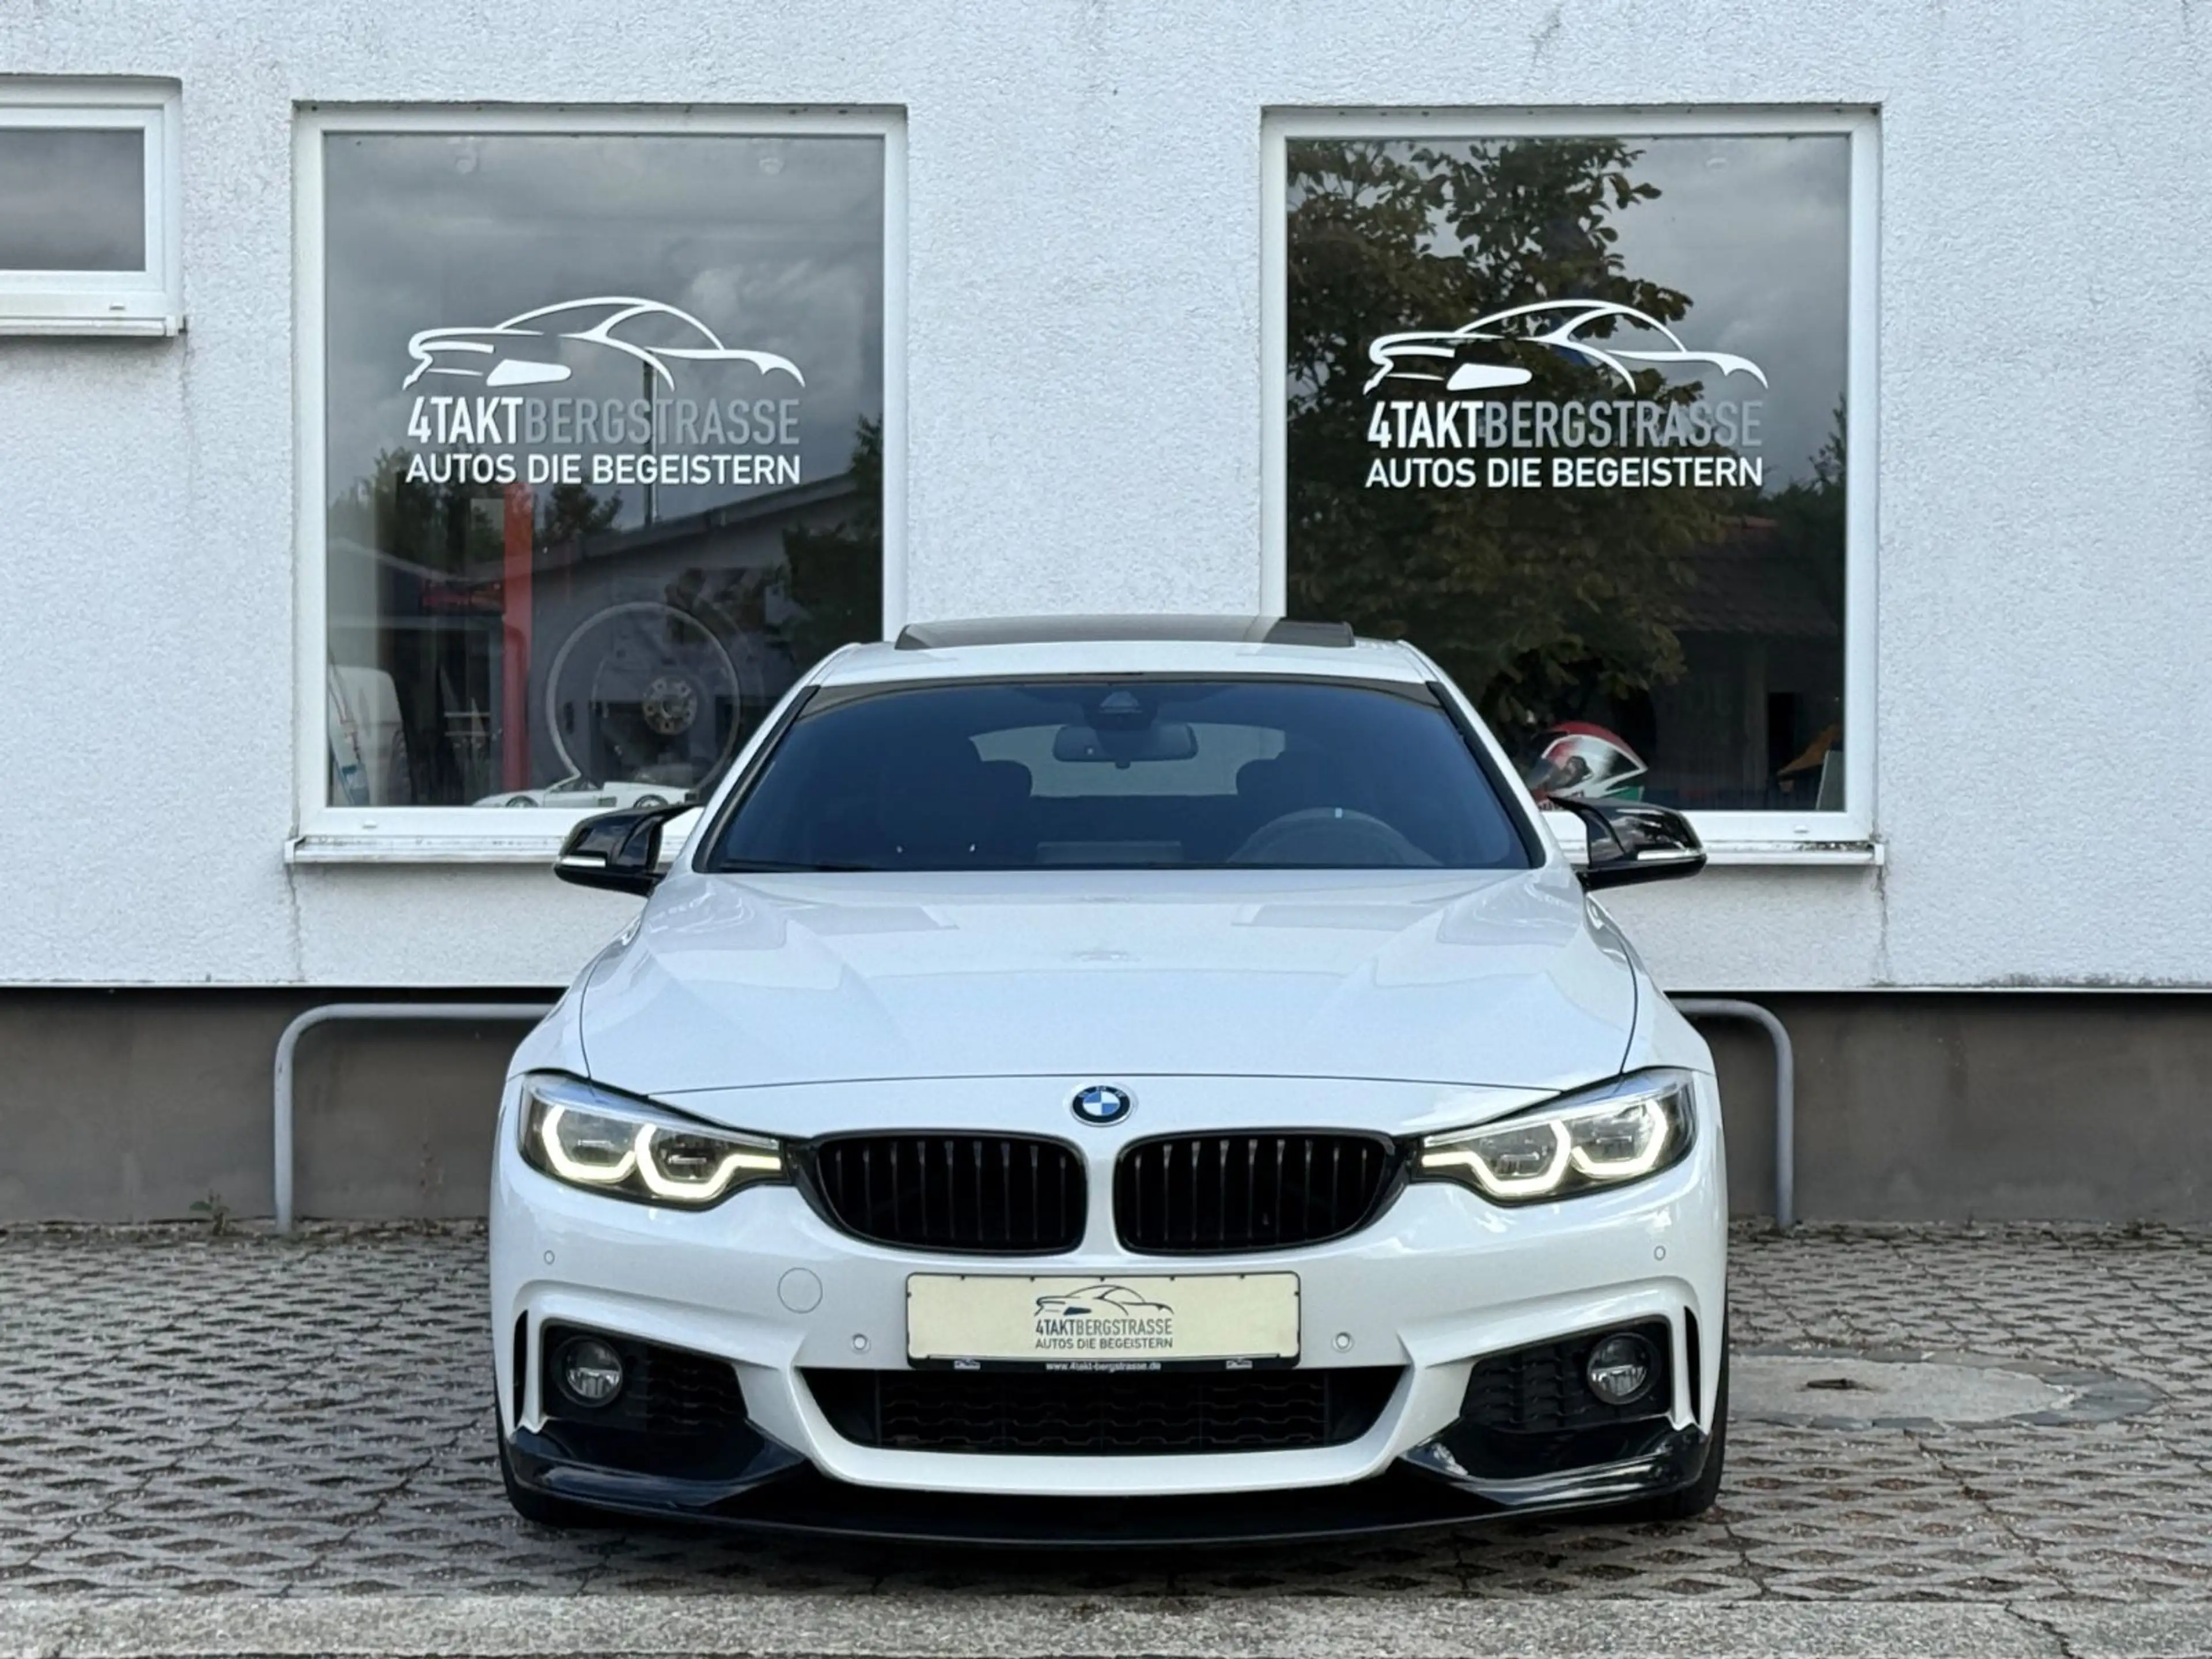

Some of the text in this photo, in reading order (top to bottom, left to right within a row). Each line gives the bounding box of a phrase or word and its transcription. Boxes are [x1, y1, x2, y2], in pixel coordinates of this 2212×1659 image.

[406, 454, 800, 485] AUTOS DIE BEGEISTERN
[1365, 457, 1763, 488] AUTOS DIE BEGEISTERN
[1036, 1338, 1173, 1349] AUTOS DIE BEGEISTERN
